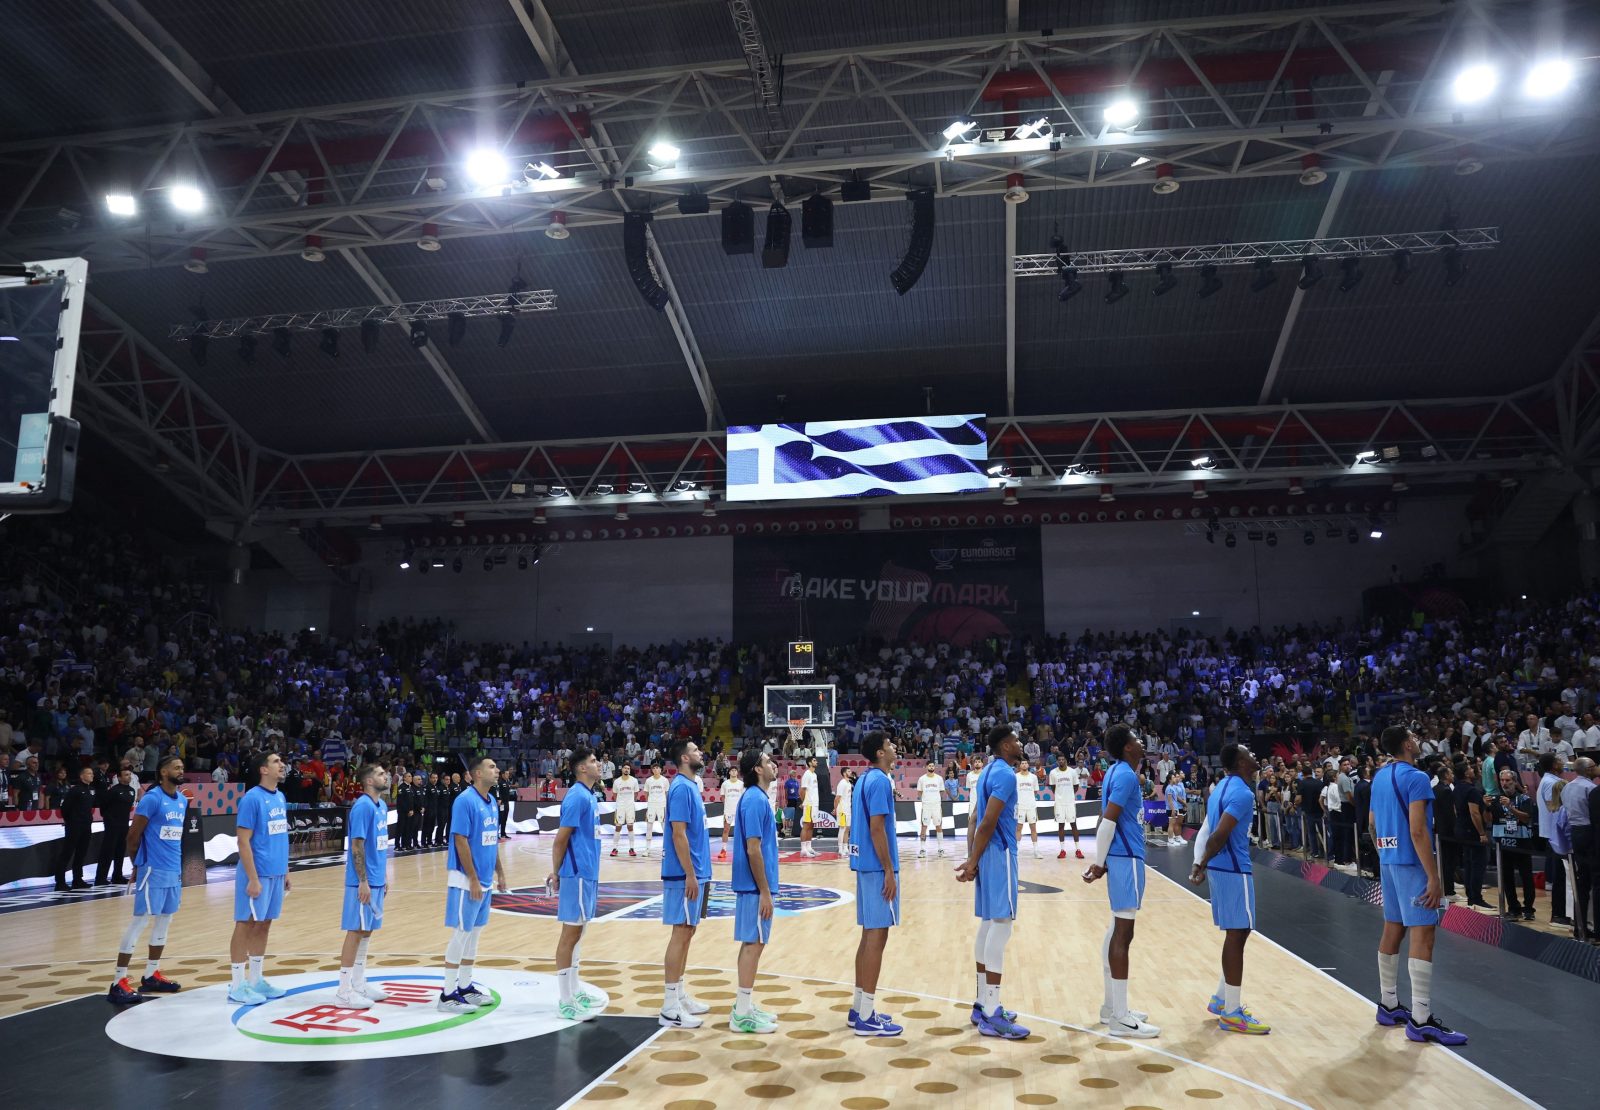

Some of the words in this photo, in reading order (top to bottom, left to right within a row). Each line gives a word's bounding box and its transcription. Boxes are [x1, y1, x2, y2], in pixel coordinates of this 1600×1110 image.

[781, 577, 856, 600] MAKE
[860, 580, 928, 602] YOUR
[932, 583, 1010, 606] MARK
